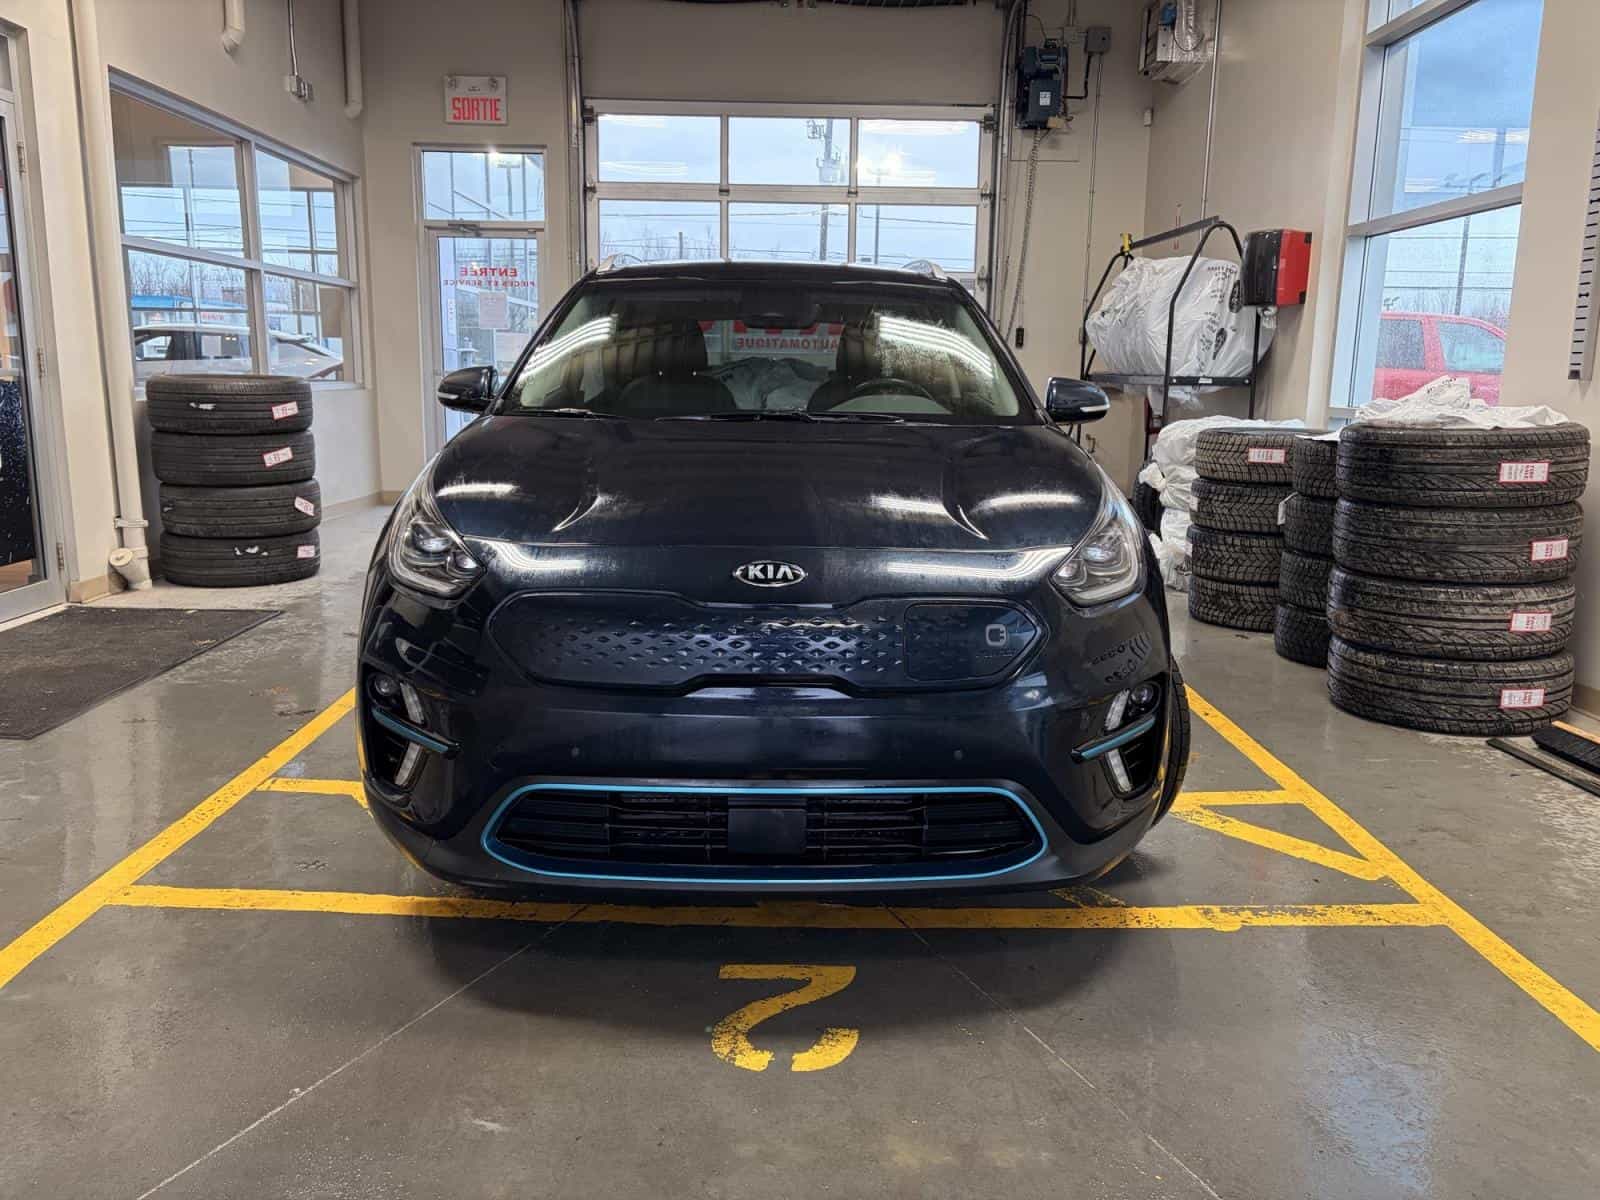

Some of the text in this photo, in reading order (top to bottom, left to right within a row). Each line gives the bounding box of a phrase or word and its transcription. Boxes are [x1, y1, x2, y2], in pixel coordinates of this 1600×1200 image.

[452, 97, 501, 121] SORTIE
[748, 564, 794, 580] KIA
[711, 963, 859, 1073] 2
